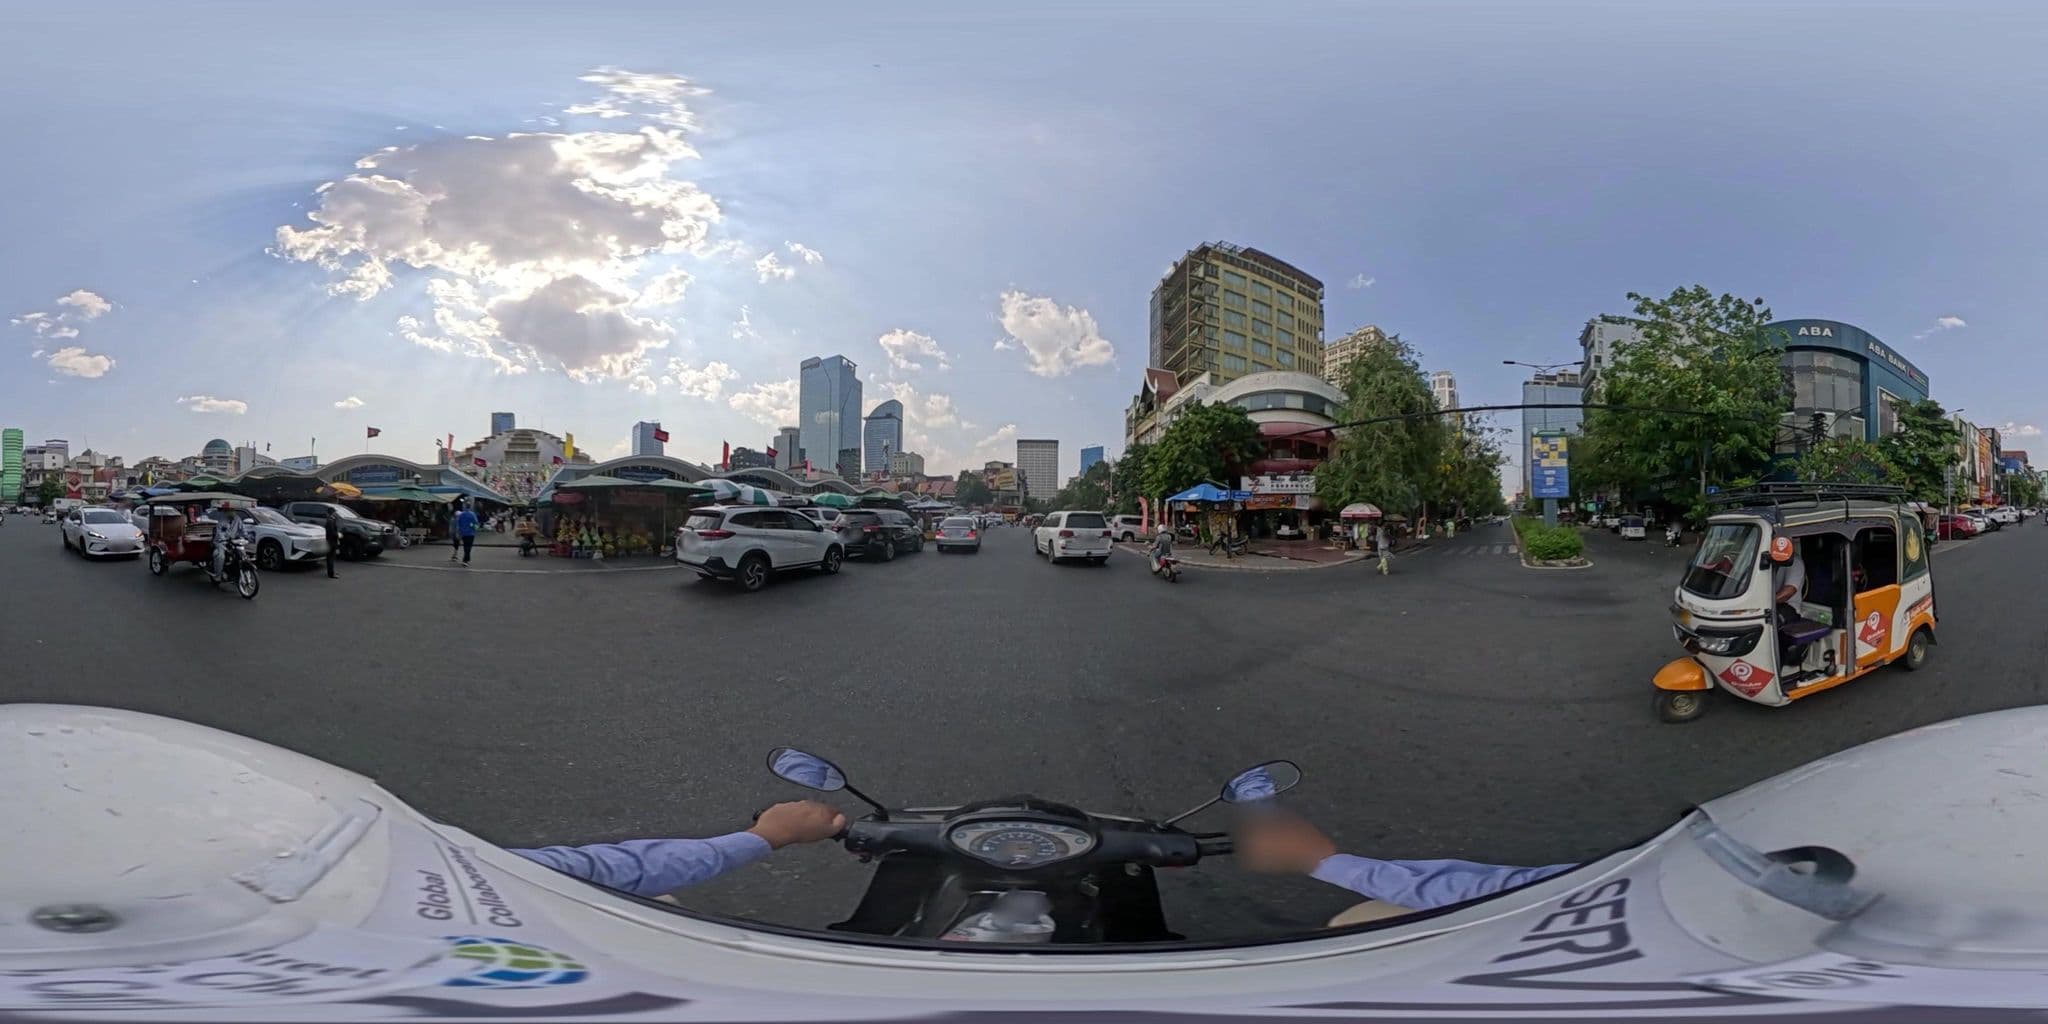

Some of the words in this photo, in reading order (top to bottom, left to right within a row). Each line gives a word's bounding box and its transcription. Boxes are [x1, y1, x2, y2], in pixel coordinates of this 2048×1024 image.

[1797, 326, 1833, 337] ABA
[1868, 342, 1886, 359] ABA
[1888, 354, 1907, 374] BANK
[416, 869, 454, 922] Global
